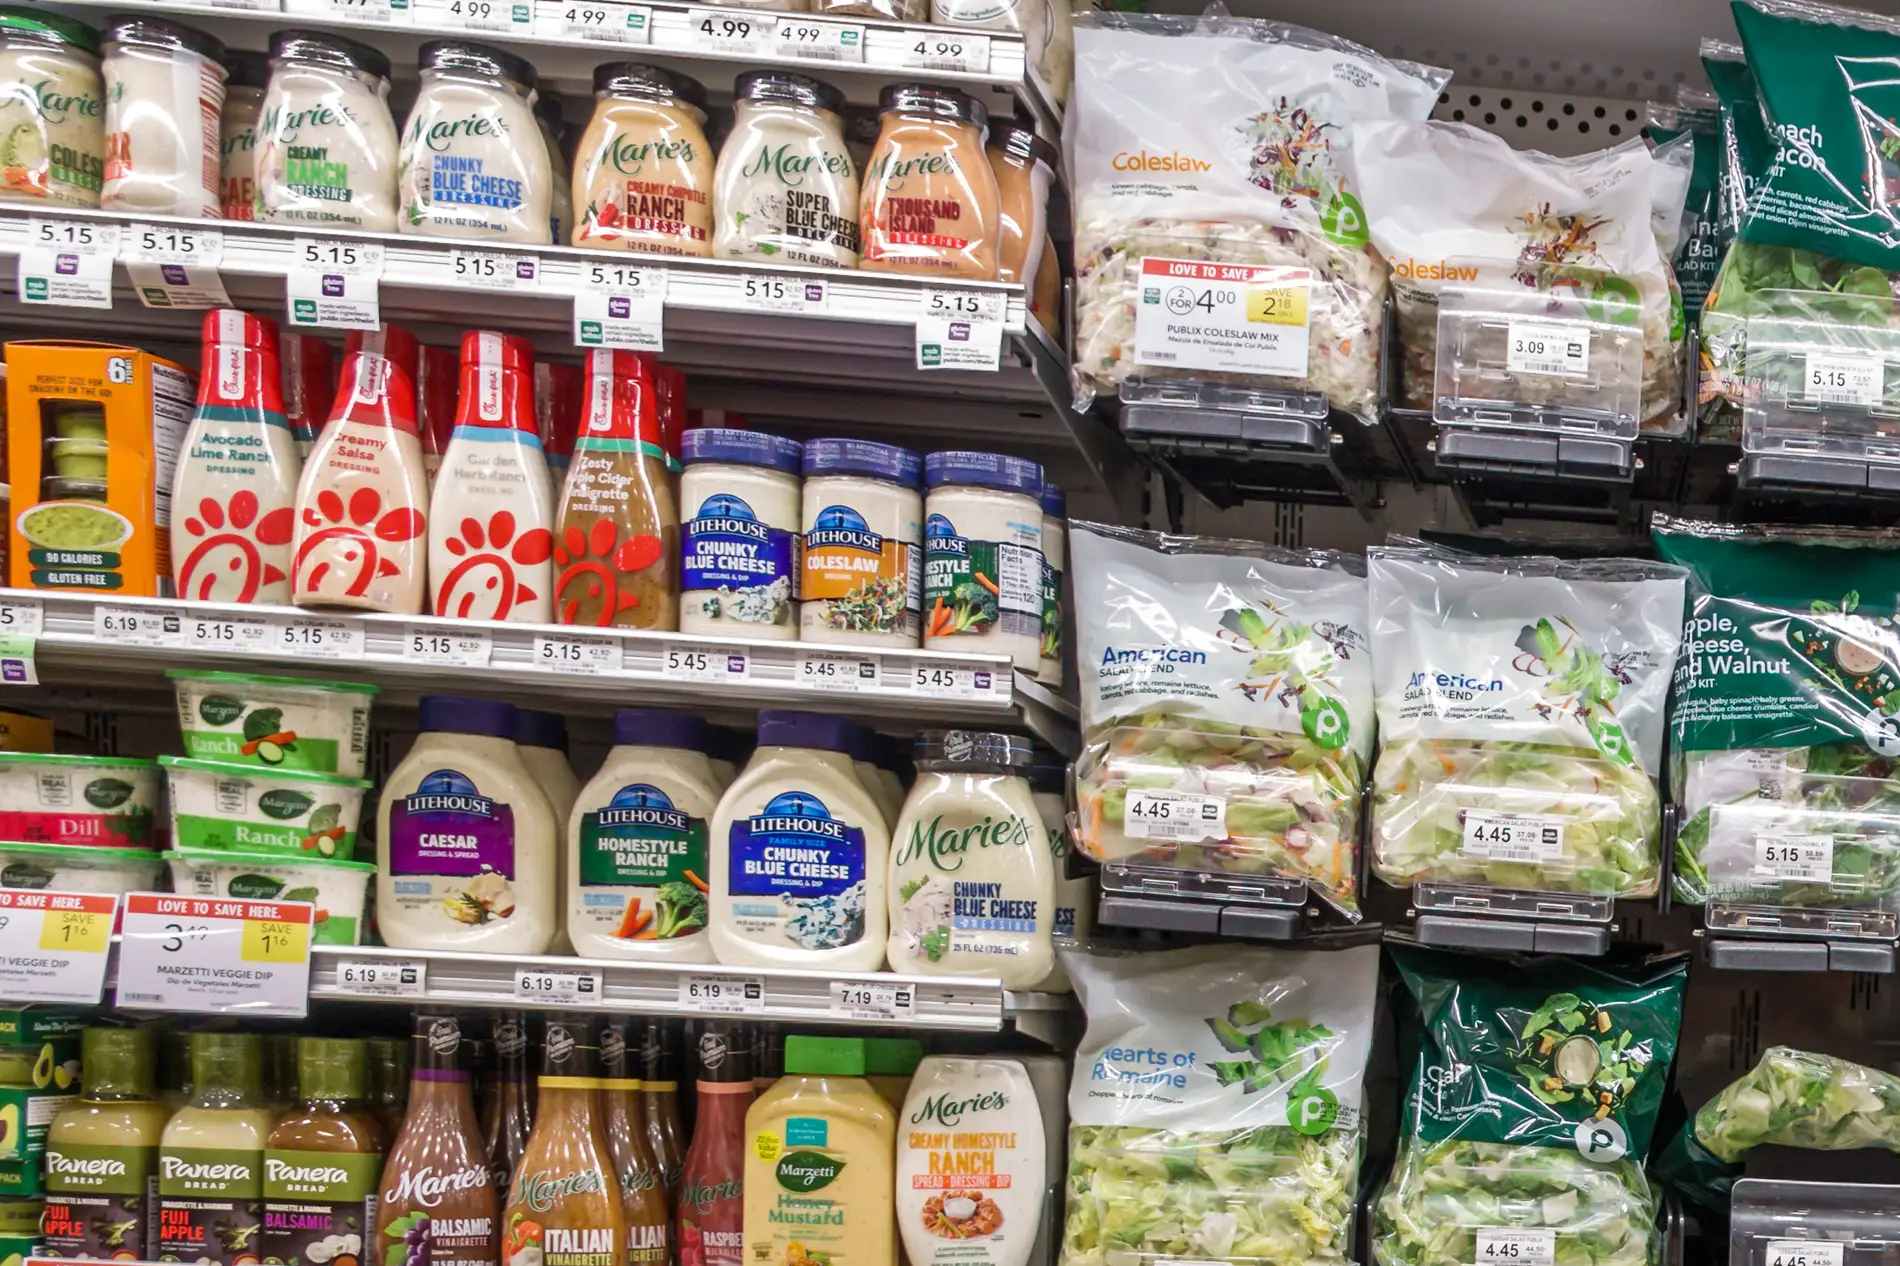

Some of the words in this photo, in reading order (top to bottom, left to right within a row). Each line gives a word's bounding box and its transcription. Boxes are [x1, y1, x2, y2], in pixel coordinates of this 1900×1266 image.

[700, 20, 750, 38] 4.99
[434, 155, 483, 173] CHUNKY
[1112, 151, 1212, 173] Coleslaw
[433, 171, 467, 191] BLUE
[471, 173, 522, 199] CHEESE
[628, 199, 684, 221] RANCH
[786, 191, 830, 212] SUPER
[888, 199, 959, 220] THOUSAND
[890, 216, 935, 233] ISLAND
[40, 225, 93, 244] 5.15
[306, 246, 356, 264] 5.15
[591, 267, 640, 285] 5.15
[930, 294, 979, 312] 5.15
[1168, 325, 1201, 338] PUBLIX
[1204, 327, 1258, 341] COLESLAW
[1259, 331, 1279, 342] MIX
[1516, 339, 1545, 355] 3.09
[202, 434, 263, 447] Avocado
[191, 449, 223, 460] Lime
[227, 450, 272, 462] Ranch
[338, 447, 375, 462] Salsa
[690, 519, 768, 541] LITEHOUSE
[807, 530, 882, 551] LITEHOUSE
[46, 552, 59, 563] 90
[61, 553, 102, 565] CALORIES
[697, 540, 756, 560] CHUNKY
[686, 554, 716, 570] BLUE
[719, 556, 775, 576] CHEESE
[808, 555, 879, 573] COLESLAW
[48, 573, 81, 585] GLUTEN
[83, 573, 105, 585] FREE
[103, 615, 137, 631] 6.19
[196, 623, 233, 640] 5.15
[669, 654, 706, 670] 5.45
[1102, 646, 1206, 666] American
[1708, 656, 1790, 675] Walnut
[406, 798, 492, 816] LITEHOUSE
[1132, 801, 1170, 819] 4.45
[60, 818, 99, 837] Dill
[599, 811, 688, 830] LITEHOUSE
[751, 817, 844, 838] LITEHOUSE
[236, 826, 301, 848] Ranch
[419, 833, 477, 850] CAESAR
[768, 837, 800, 846] FAMILY
[803, 838, 826, 847] SIZE
[898, 814, 1034, 870] Marie's
[598, 838, 688, 855] HOMESTYLE
[763, 846, 831, 863] CHUNKY
[1766, 845, 1799, 862] 5.15
[616, 852, 668, 868] RANCH
[745, 860, 791, 875] BLUE
[794, 861, 849, 879] CHEESE
[954, 882, 1002, 900] CHUNKY
[158, 900, 189, 913] LOVE
[194, 902, 207, 914] TO
[213, 903, 243, 916] SAVE
[248, 905, 281, 919] HERE.
[954, 898, 987, 918] BLUE
[990, 899, 1037, 920] CHEESE
[261, 922, 292, 935] SAVE
[157, 965, 209, 979] MARZETTI
[213, 969, 252, 980] VEGGIE
[254, 970, 273, 980] DIP
[345, 968, 376, 983] 6.19
[522, 975, 553, 991] 6.19
[842, 989, 871, 1005] 7.19
[911, 1090, 1009, 1127] Marie's
[910, 1133, 949, 1151] CREAMY
[953, 1133, 1017, 1150] HOMESTYLE
[160, 1156, 251, 1182] Panera
[928, 1151, 995, 1174] RANCH
[780, 1164, 835, 1187] Marzetti
[184, 1180, 228, 1190] BREAD
[385, 1164, 490, 1206] Marie's
[161, 1210, 188, 1226] FUJI
[265, 1213, 333, 1230] BALSAMIC
[768, 1209, 844, 1226] Mustard
[161, 1225, 203, 1241] APPLE
[431, 1219, 491, 1237] BALSAMIC
[545, 1230, 614, 1253] ITALIAN
[546, 1253, 612, 1266] VINAIGRETTE
